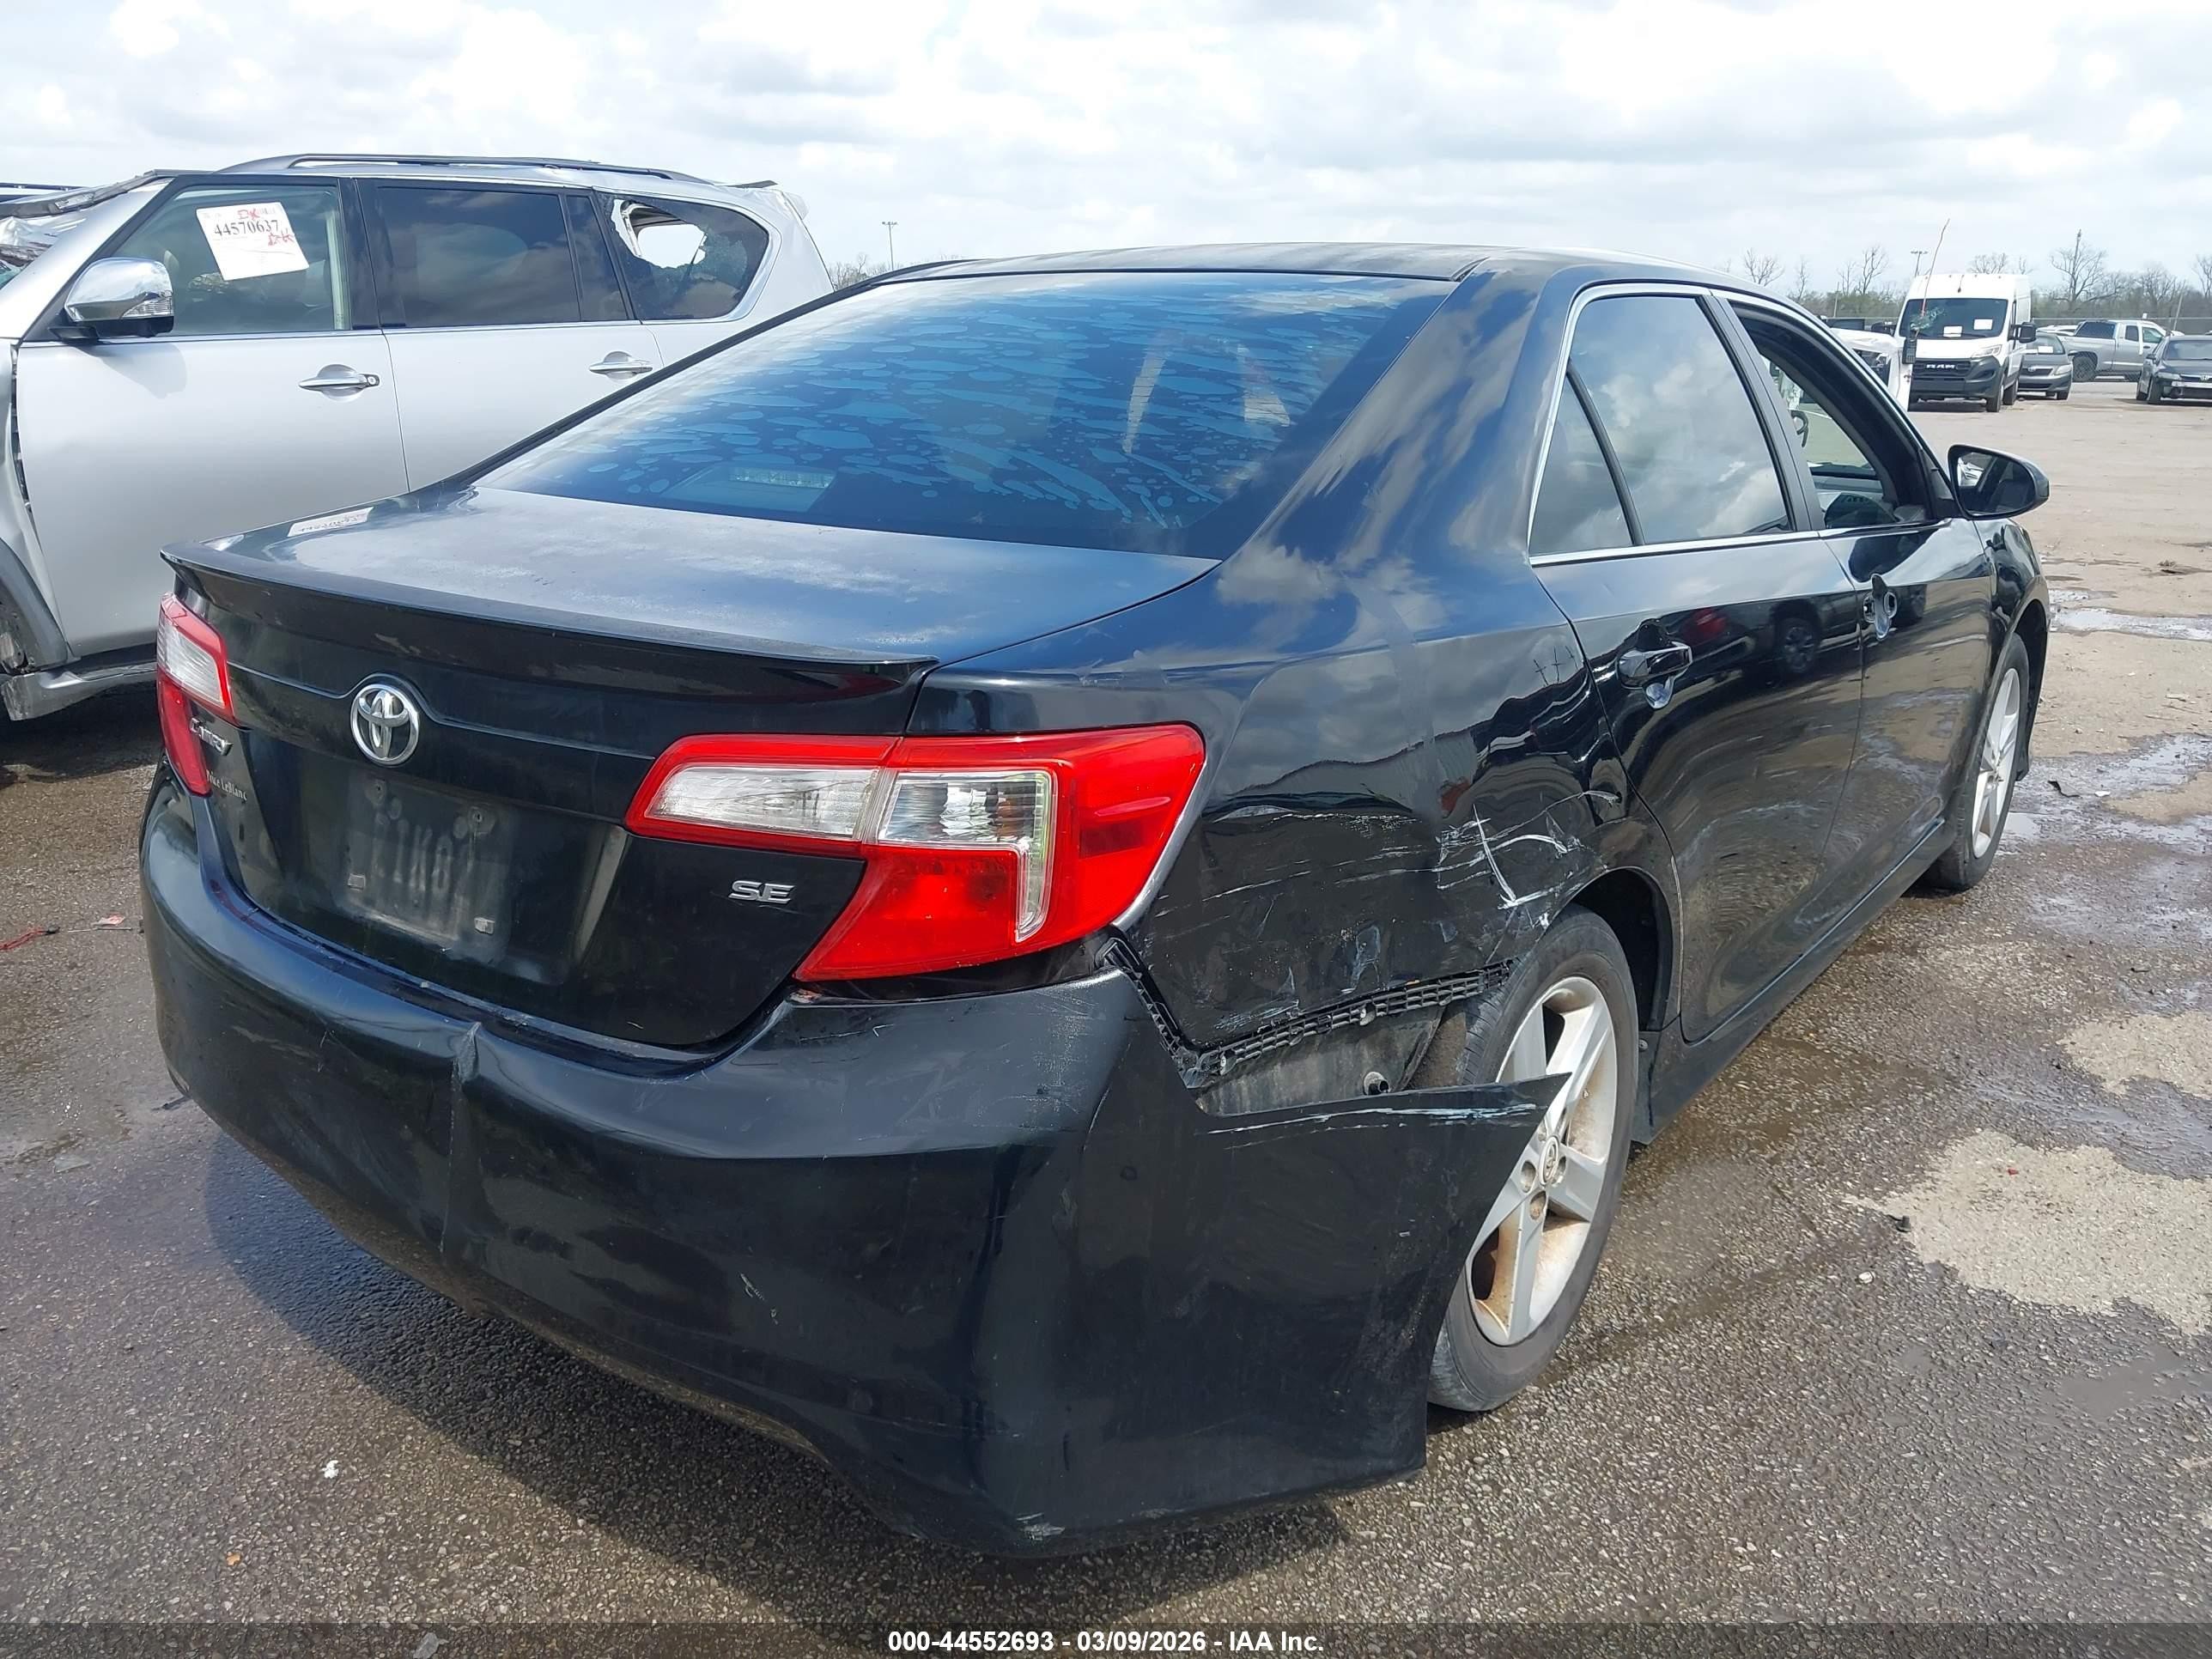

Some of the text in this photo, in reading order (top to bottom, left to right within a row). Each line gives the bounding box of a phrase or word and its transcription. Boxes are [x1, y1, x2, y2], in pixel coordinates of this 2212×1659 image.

[214, 220, 279, 236] 44570637
[221, 778, 248, 801] LeBlanc
[728, 880, 795, 904] SE
